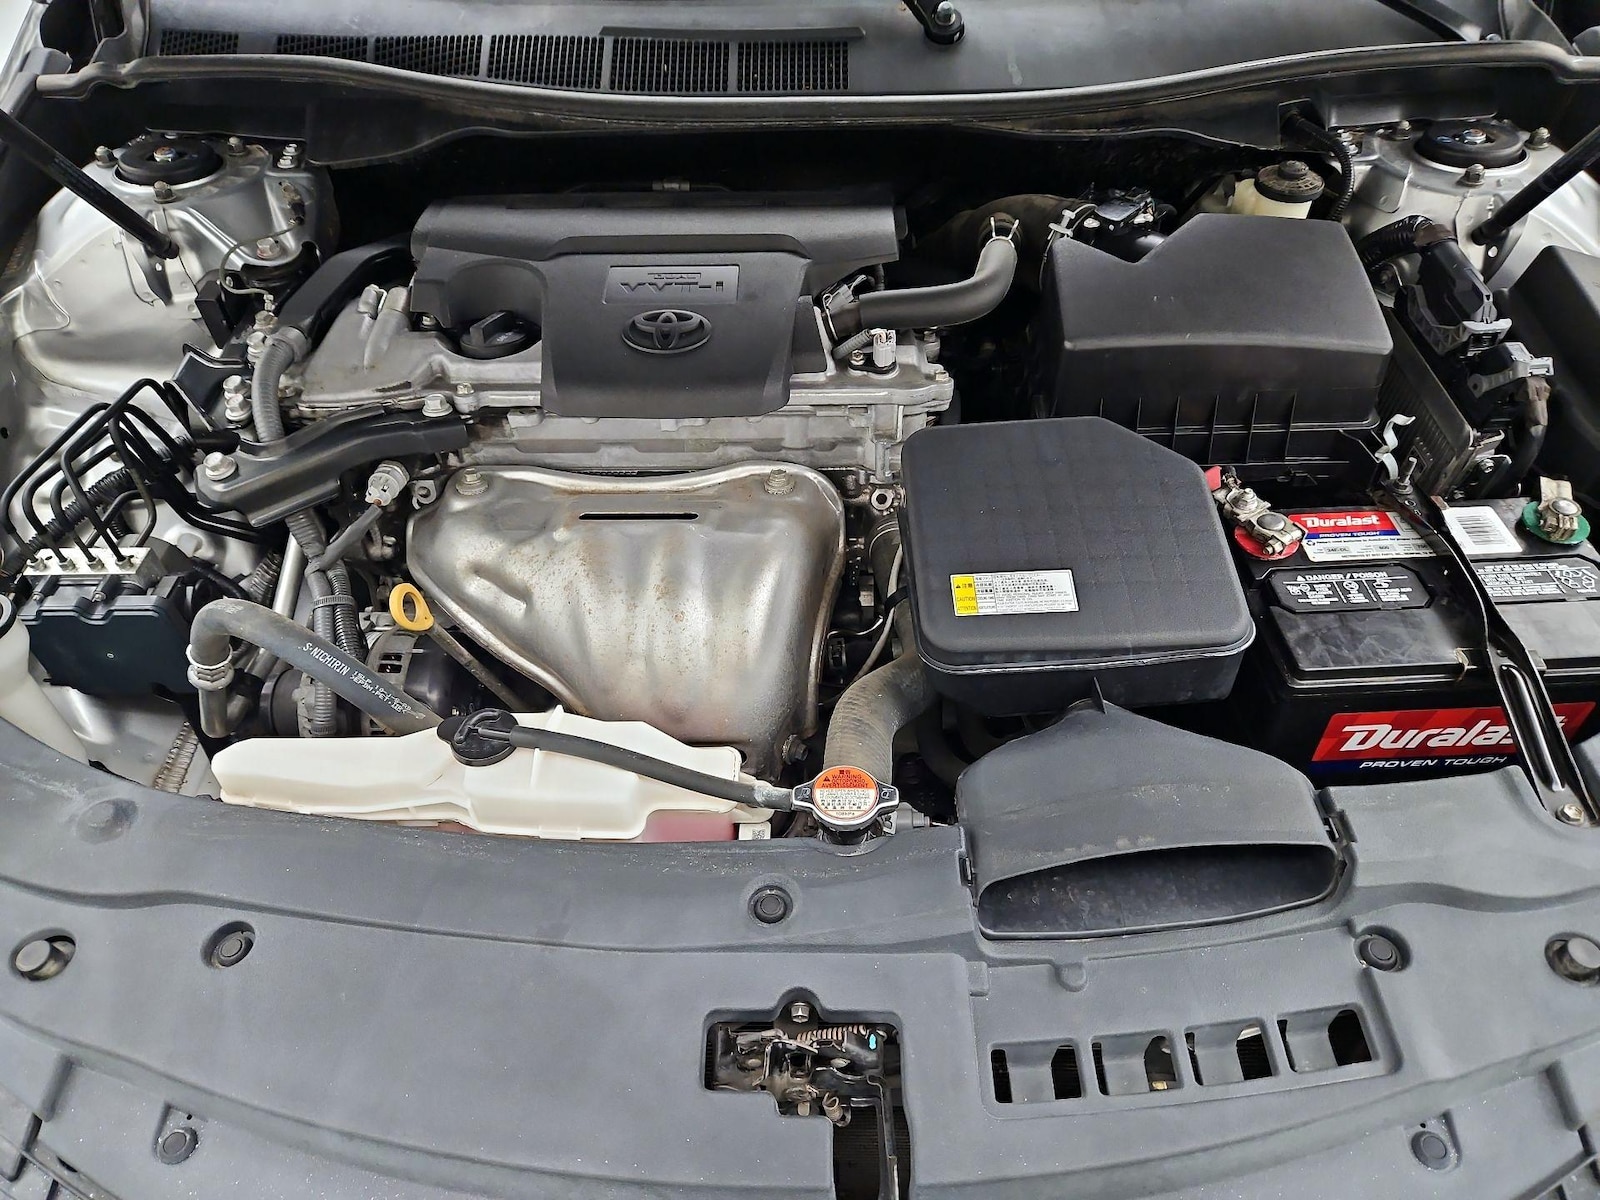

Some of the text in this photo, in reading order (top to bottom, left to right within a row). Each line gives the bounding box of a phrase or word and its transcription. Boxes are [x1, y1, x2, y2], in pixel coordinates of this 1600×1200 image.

[1301, 514, 1380, 528] Duralast
[1305, 573, 1344, 581] DANGER
[1353, 571, 1388, 579] POISON
[1340, 715, 1568, 752] Durala
[1359, 755, 1507, 769] PROVEN TOUGH
